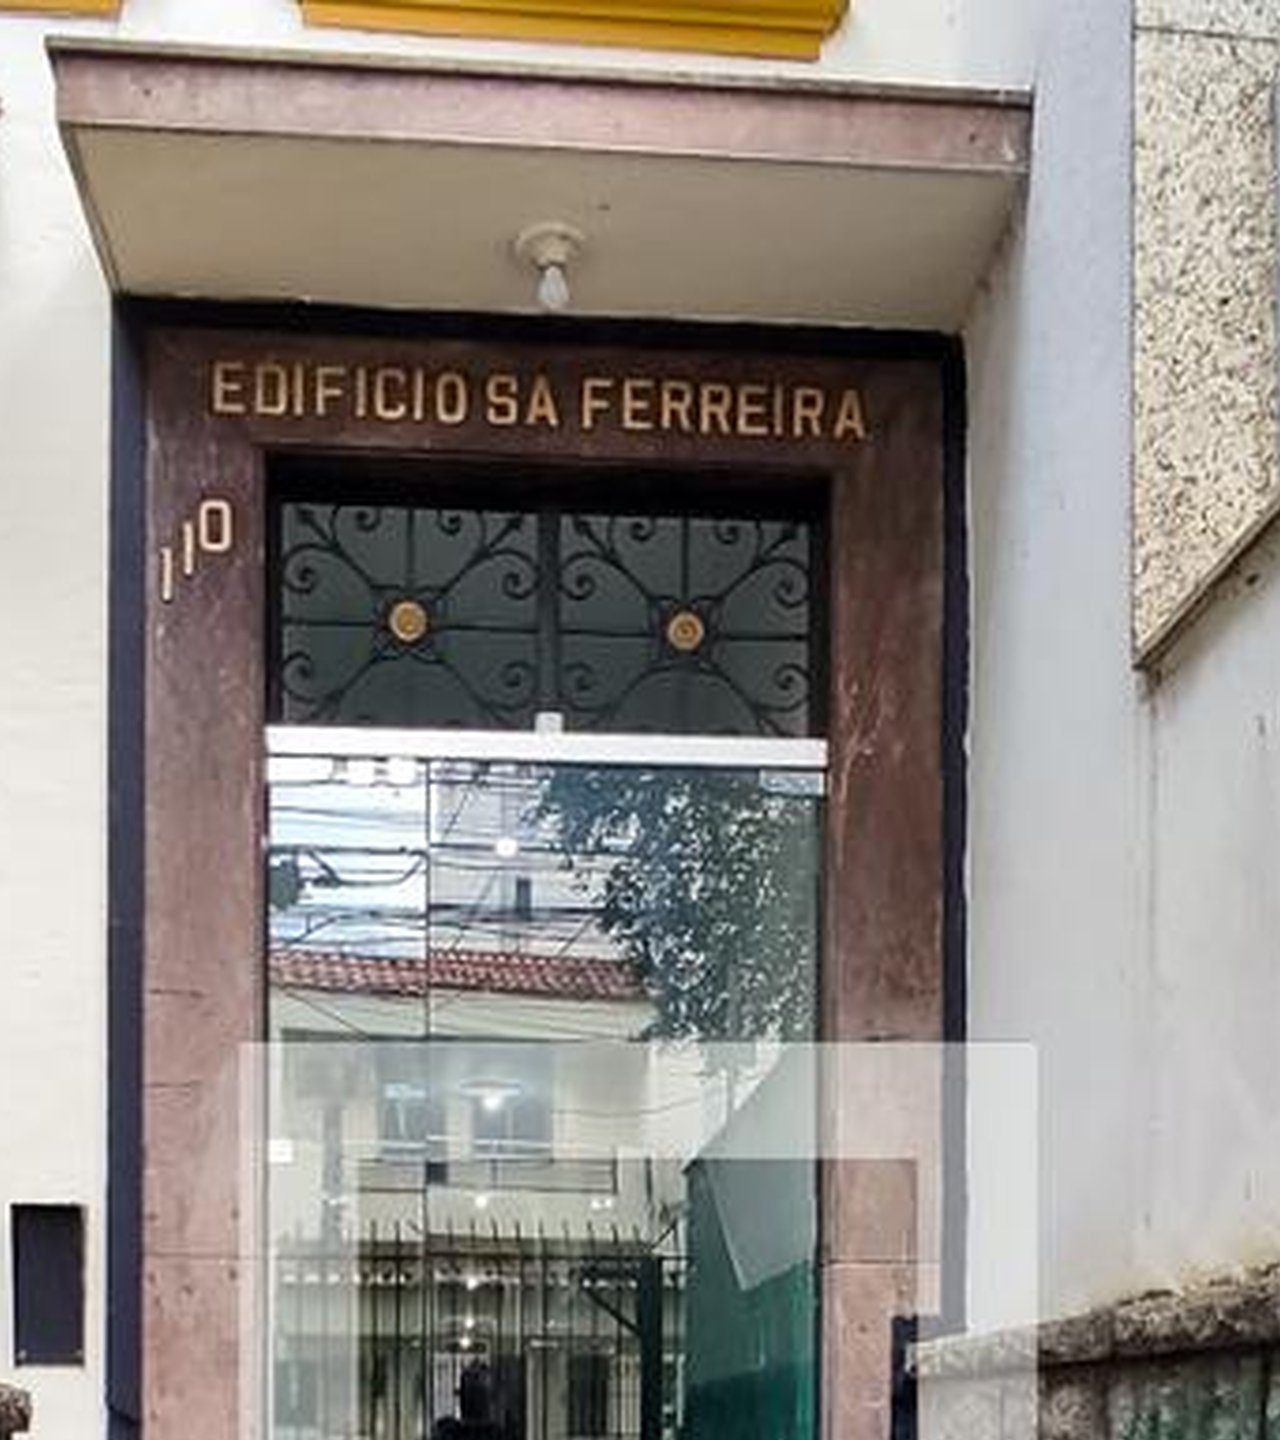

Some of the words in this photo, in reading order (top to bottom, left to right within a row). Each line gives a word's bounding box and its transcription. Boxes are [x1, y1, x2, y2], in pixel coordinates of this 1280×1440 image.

[212, 361, 468, 423] EDIFICIO
[487, 374, 558, 426] SA
[581, 377, 867, 439] FERREIRA
[160, 500, 232, 600] 110
